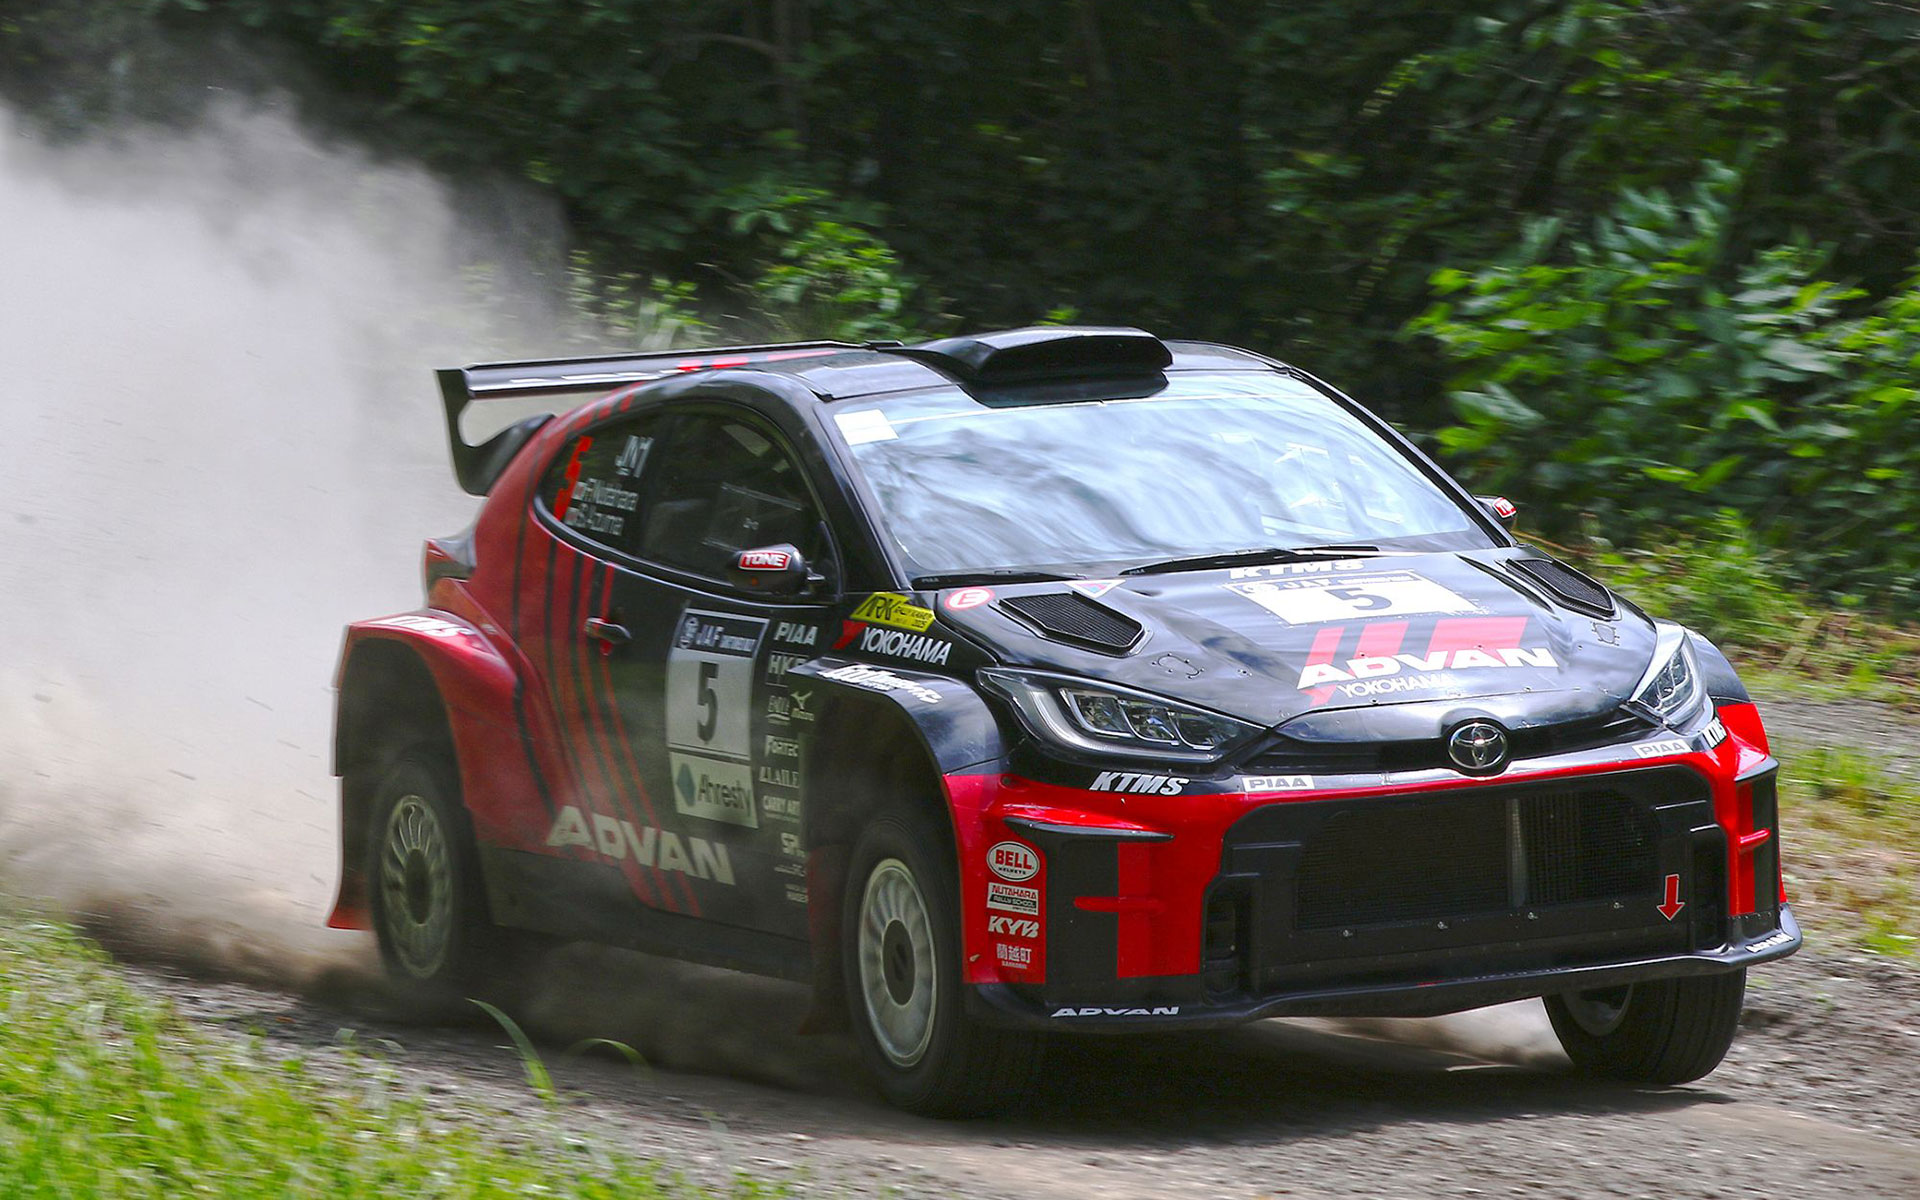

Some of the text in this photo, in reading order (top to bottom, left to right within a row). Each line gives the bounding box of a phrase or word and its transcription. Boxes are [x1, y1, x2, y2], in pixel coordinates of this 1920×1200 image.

[744, 551, 786, 567] TONE
[1230, 559, 1365, 579] KTMS
[957, 592, 982, 605] E
[1324, 588, 1392, 610] 5
[696, 624, 725, 647] JAF
[774, 622, 818, 646] PIAA
[860, 627, 952, 666] YOKOHAMA
[1297, 648, 1559, 690] ADVAN
[1337, 673, 1457, 698] YOKOHAMA
[697, 661, 719, 742] 5
[1703, 716, 1727, 749] KTMS
[1639, 740, 1686, 756] PIAA
[1089, 772, 1190, 795] KTMS
[1250, 777, 1308, 789] PIAA
[546, 805, 736, 886] ADVAN
[995, 849, 1033, 870] BELL
[991, 885, 1037, 900] NUTAHARA
[1012, 898, 1035, 908] SCHOOL
[988, 915, 1040, 938] KYB
[1051, 1006, 1180, 1018] ADVAN
